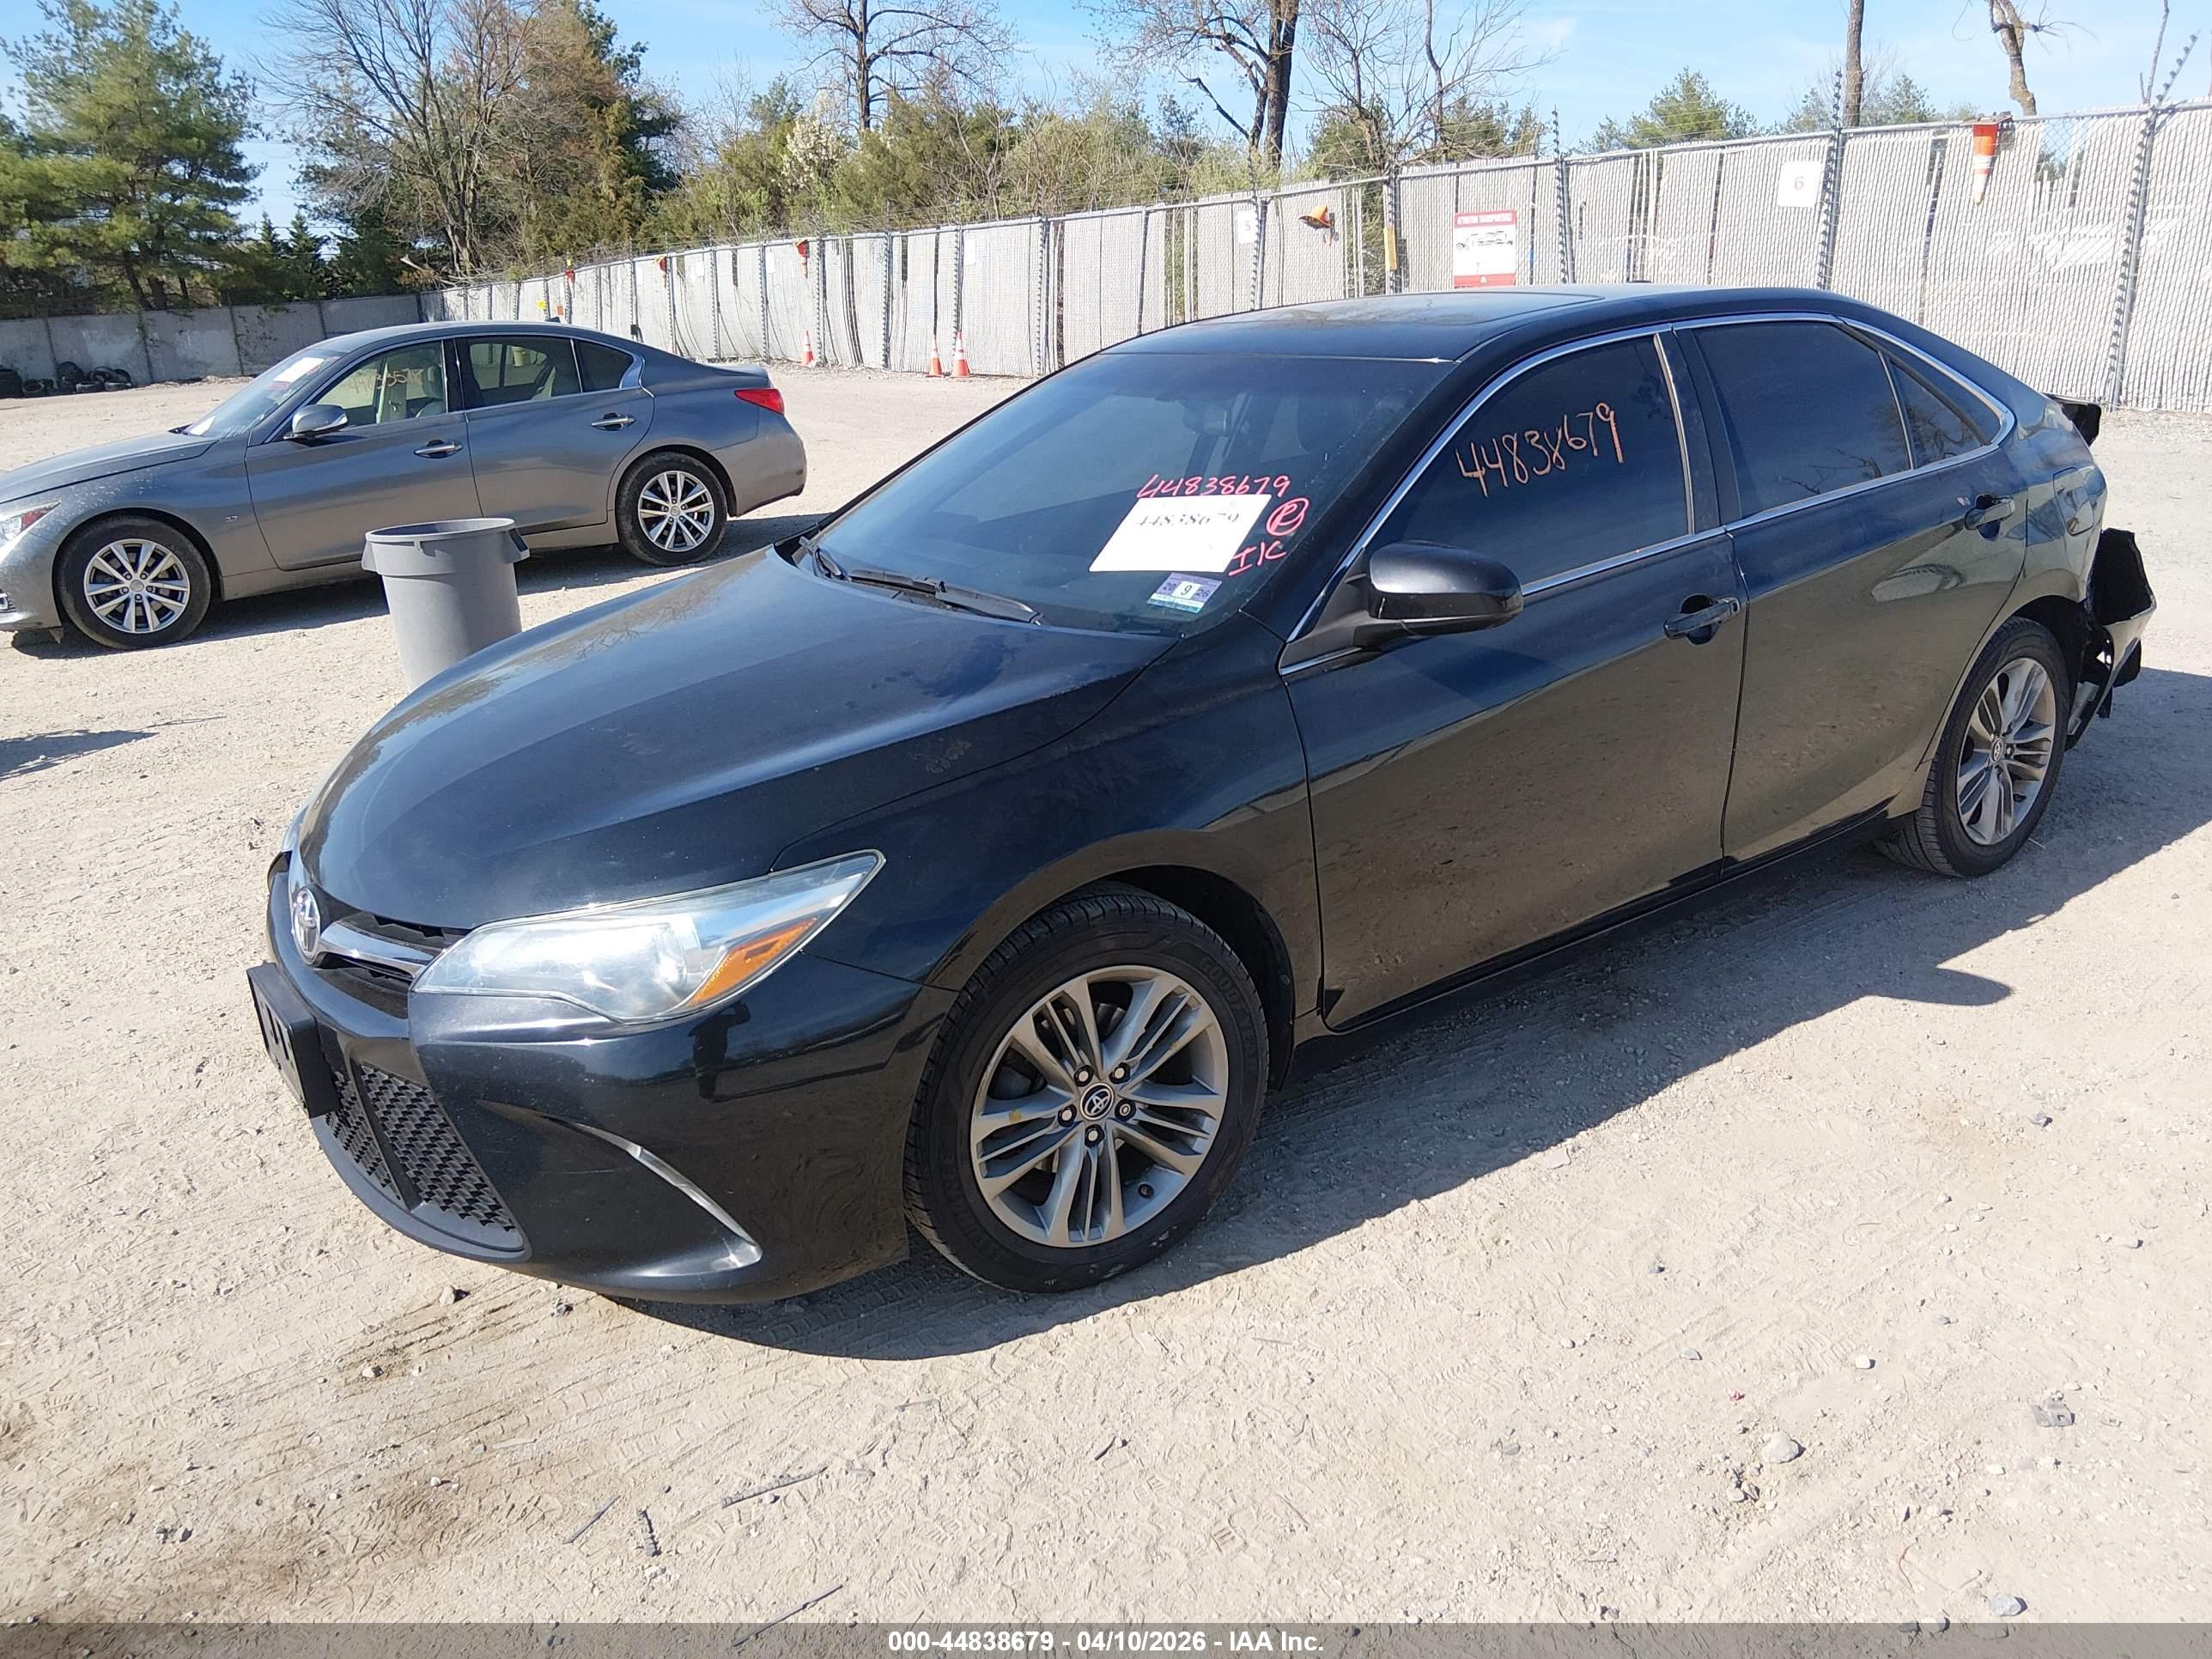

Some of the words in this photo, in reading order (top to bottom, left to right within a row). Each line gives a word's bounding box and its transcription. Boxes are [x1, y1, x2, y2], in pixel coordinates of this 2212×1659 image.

[1455, 401, 1625, 498] 44838679
[1135, 473, 1291, 498] 44838679
[1180, 584, 1194, 596] 9
